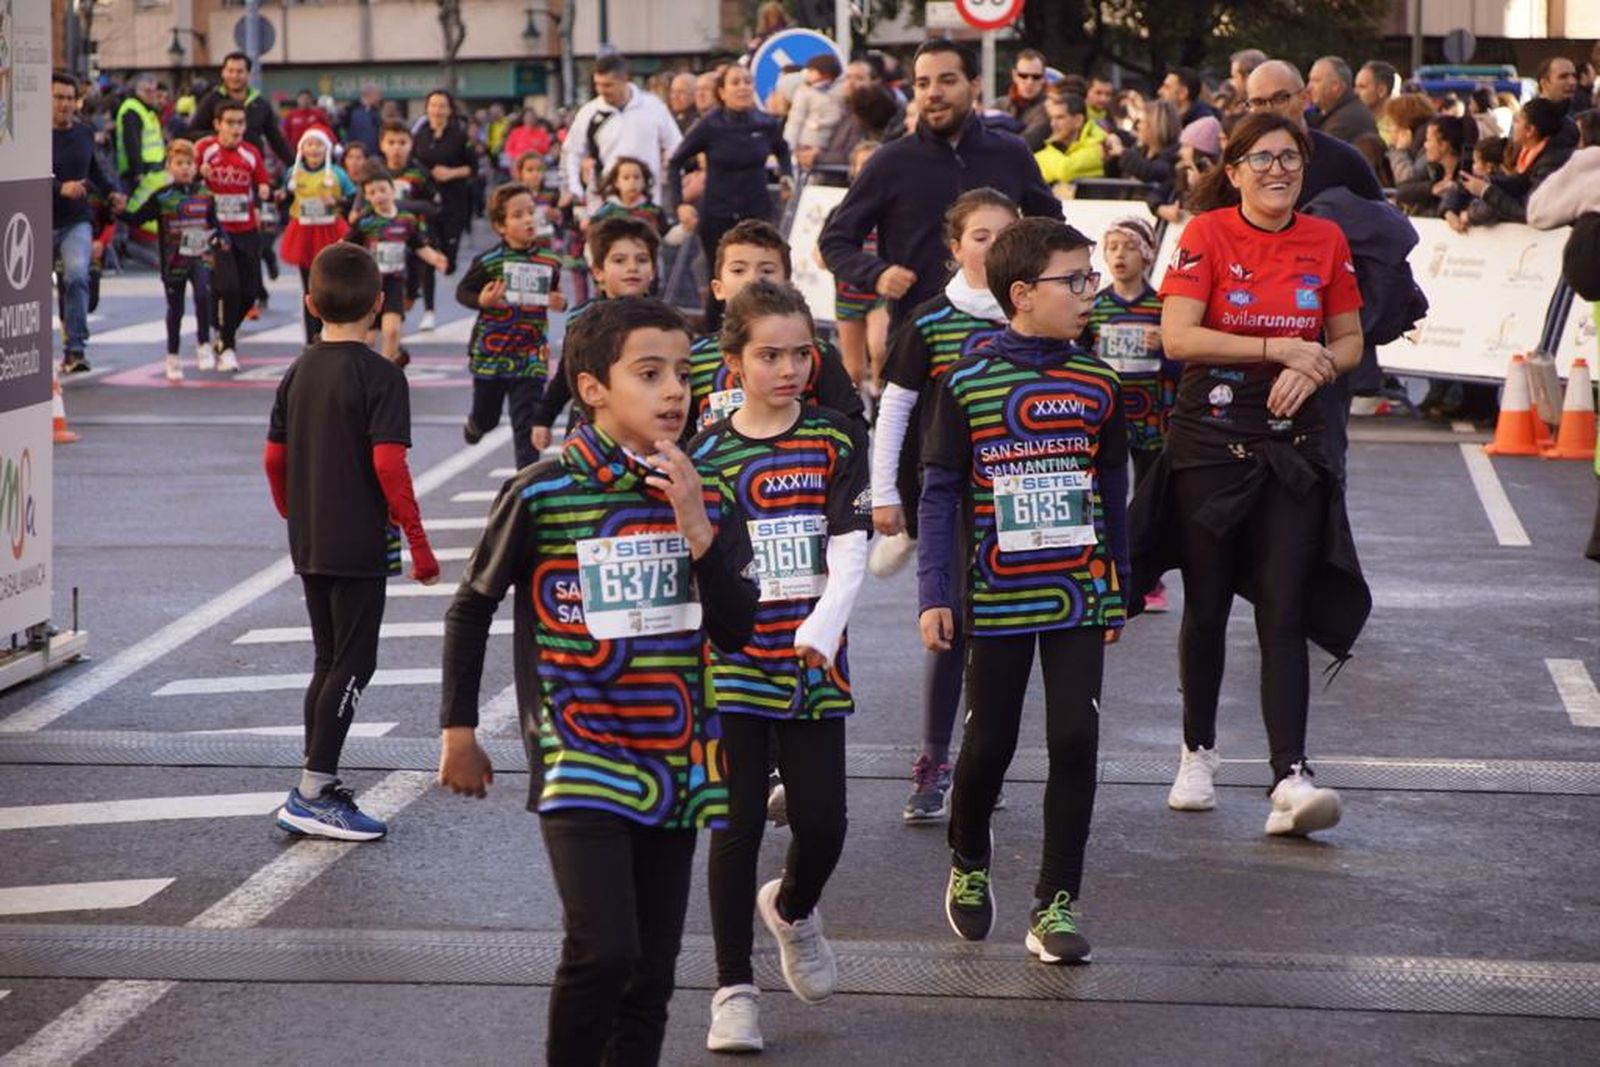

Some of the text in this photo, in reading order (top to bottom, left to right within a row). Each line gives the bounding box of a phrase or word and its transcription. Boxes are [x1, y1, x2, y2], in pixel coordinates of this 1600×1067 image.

[1221, 310, 1316, 329] avilarunners
[980, 444, 1011, 462] SAN
[764, 472, 822, 493] XXXVIII
[1022, 475, 1082, 490] SETEL
[1013, 491, 1072, 524] 6135
[600, 558, 679, 603] 6373
